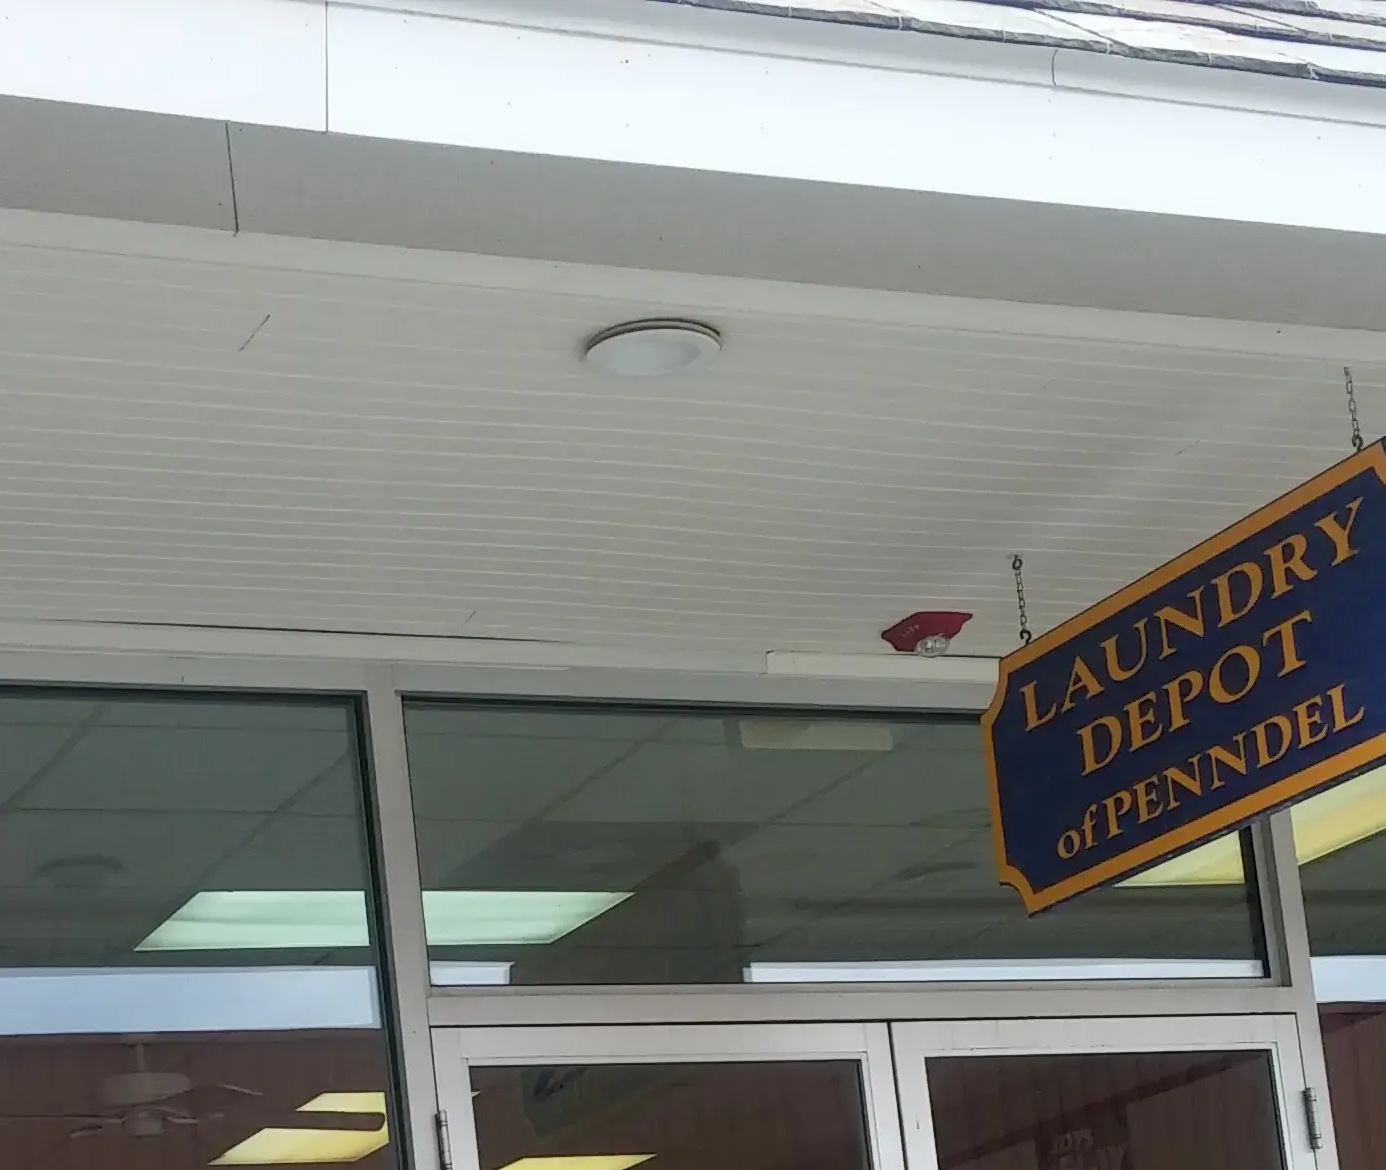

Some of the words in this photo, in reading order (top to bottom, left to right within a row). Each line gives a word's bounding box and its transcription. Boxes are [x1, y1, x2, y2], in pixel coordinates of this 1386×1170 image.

[1019, 497, 1364, 732] LAUNDRY
[1077, 610, 1312, 777] DEPOT
[1056, 804, 1099, 860] of
[1101, 683, 1365, 841] PENNDEL
